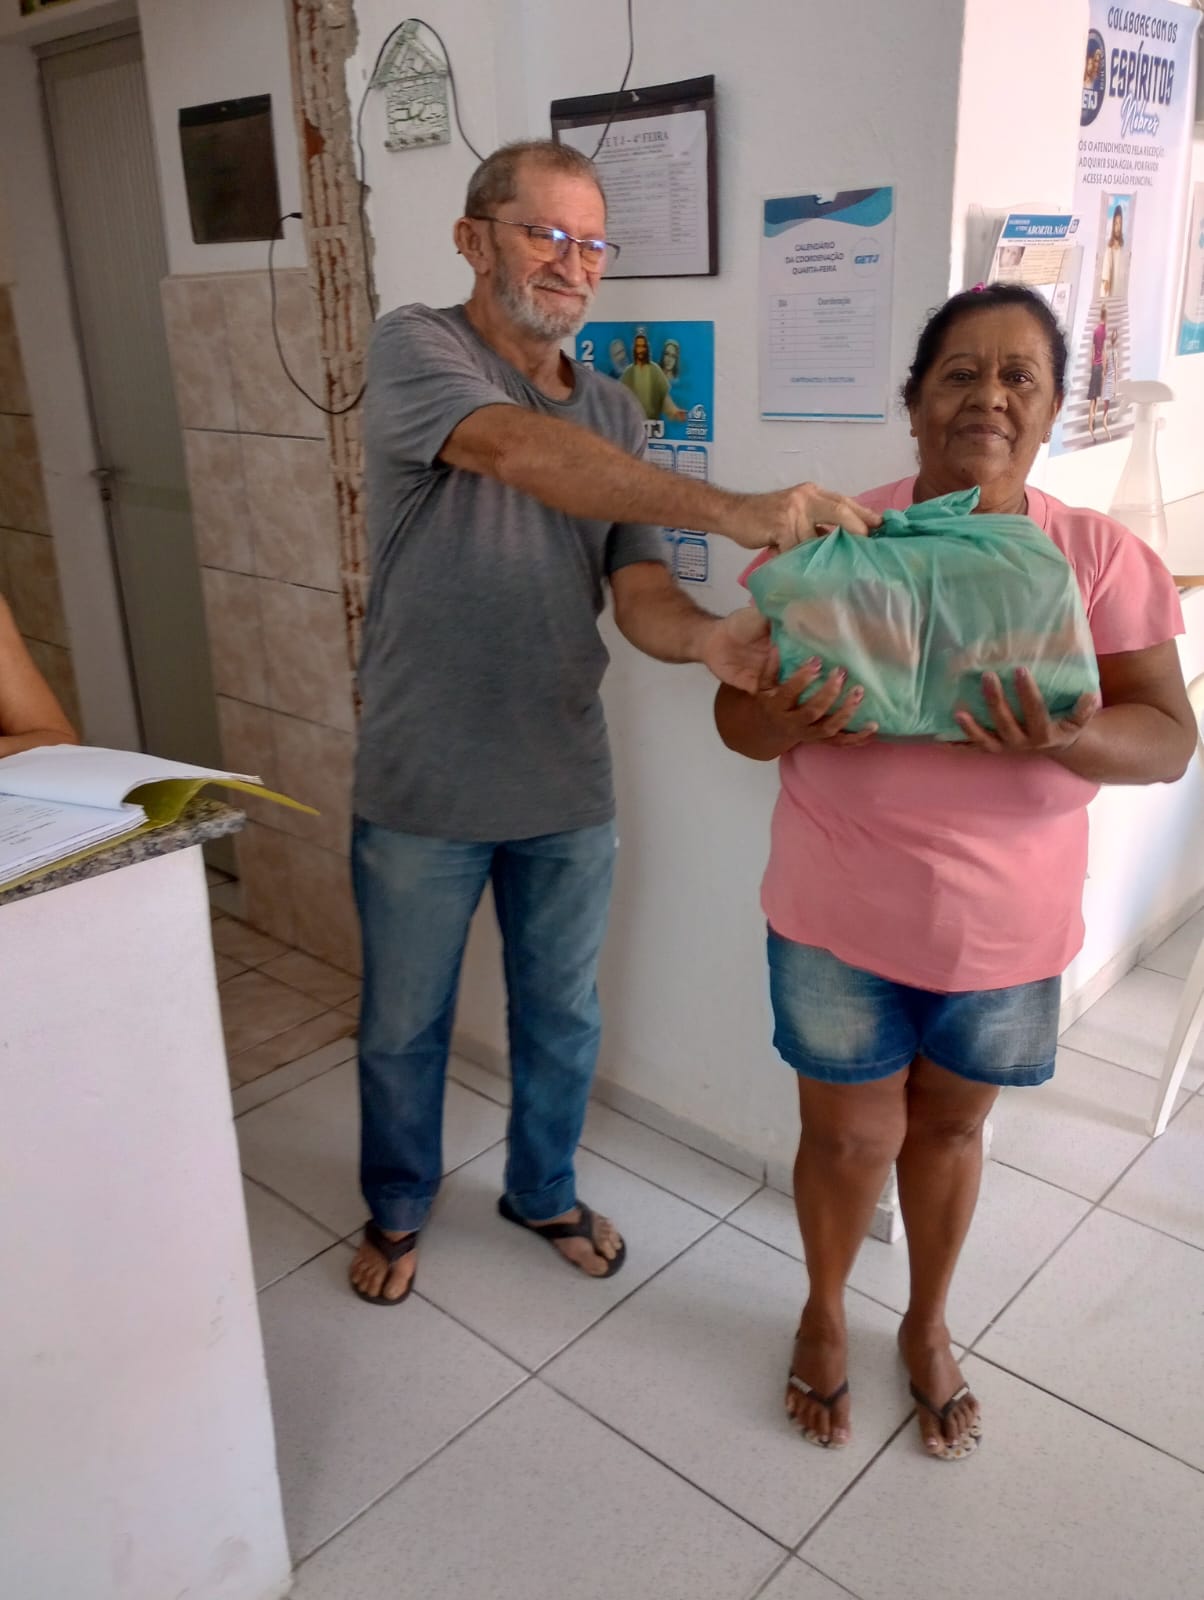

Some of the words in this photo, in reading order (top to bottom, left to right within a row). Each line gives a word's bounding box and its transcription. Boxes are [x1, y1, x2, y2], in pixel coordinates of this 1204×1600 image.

[1107, 6, 1150, 38] COLABORE
[1151, 18, 1168, 41] COM
[1167, 21, 1178, 44] OS
[1109, 40, 1176, 106] ESPÍRITOS
[1081, 89, 1098, 110] ETJ
[1120, 92, 1160, 139] Nobres
[642, 130, 669, 143] FEIRA
[1094, 141, 1131, 154] ATENDIMENTO
[1131, 144, 1143, 156] PELA
[1106, 158, 1118, 169] SUA
[1082, 173, 1103, 184] ACESSE
[1103, 174, 1113, 185] AO
[1113, 172, 1130, 185] SALÃO
[794, 241, 836, 252] CALENDÁRIO
[795, 252, 845, 264] COORDENAÇÃO
[854, 254, 880, 265] GETJ
[792, 265, 837, 275] QUARTA-FEIRA
